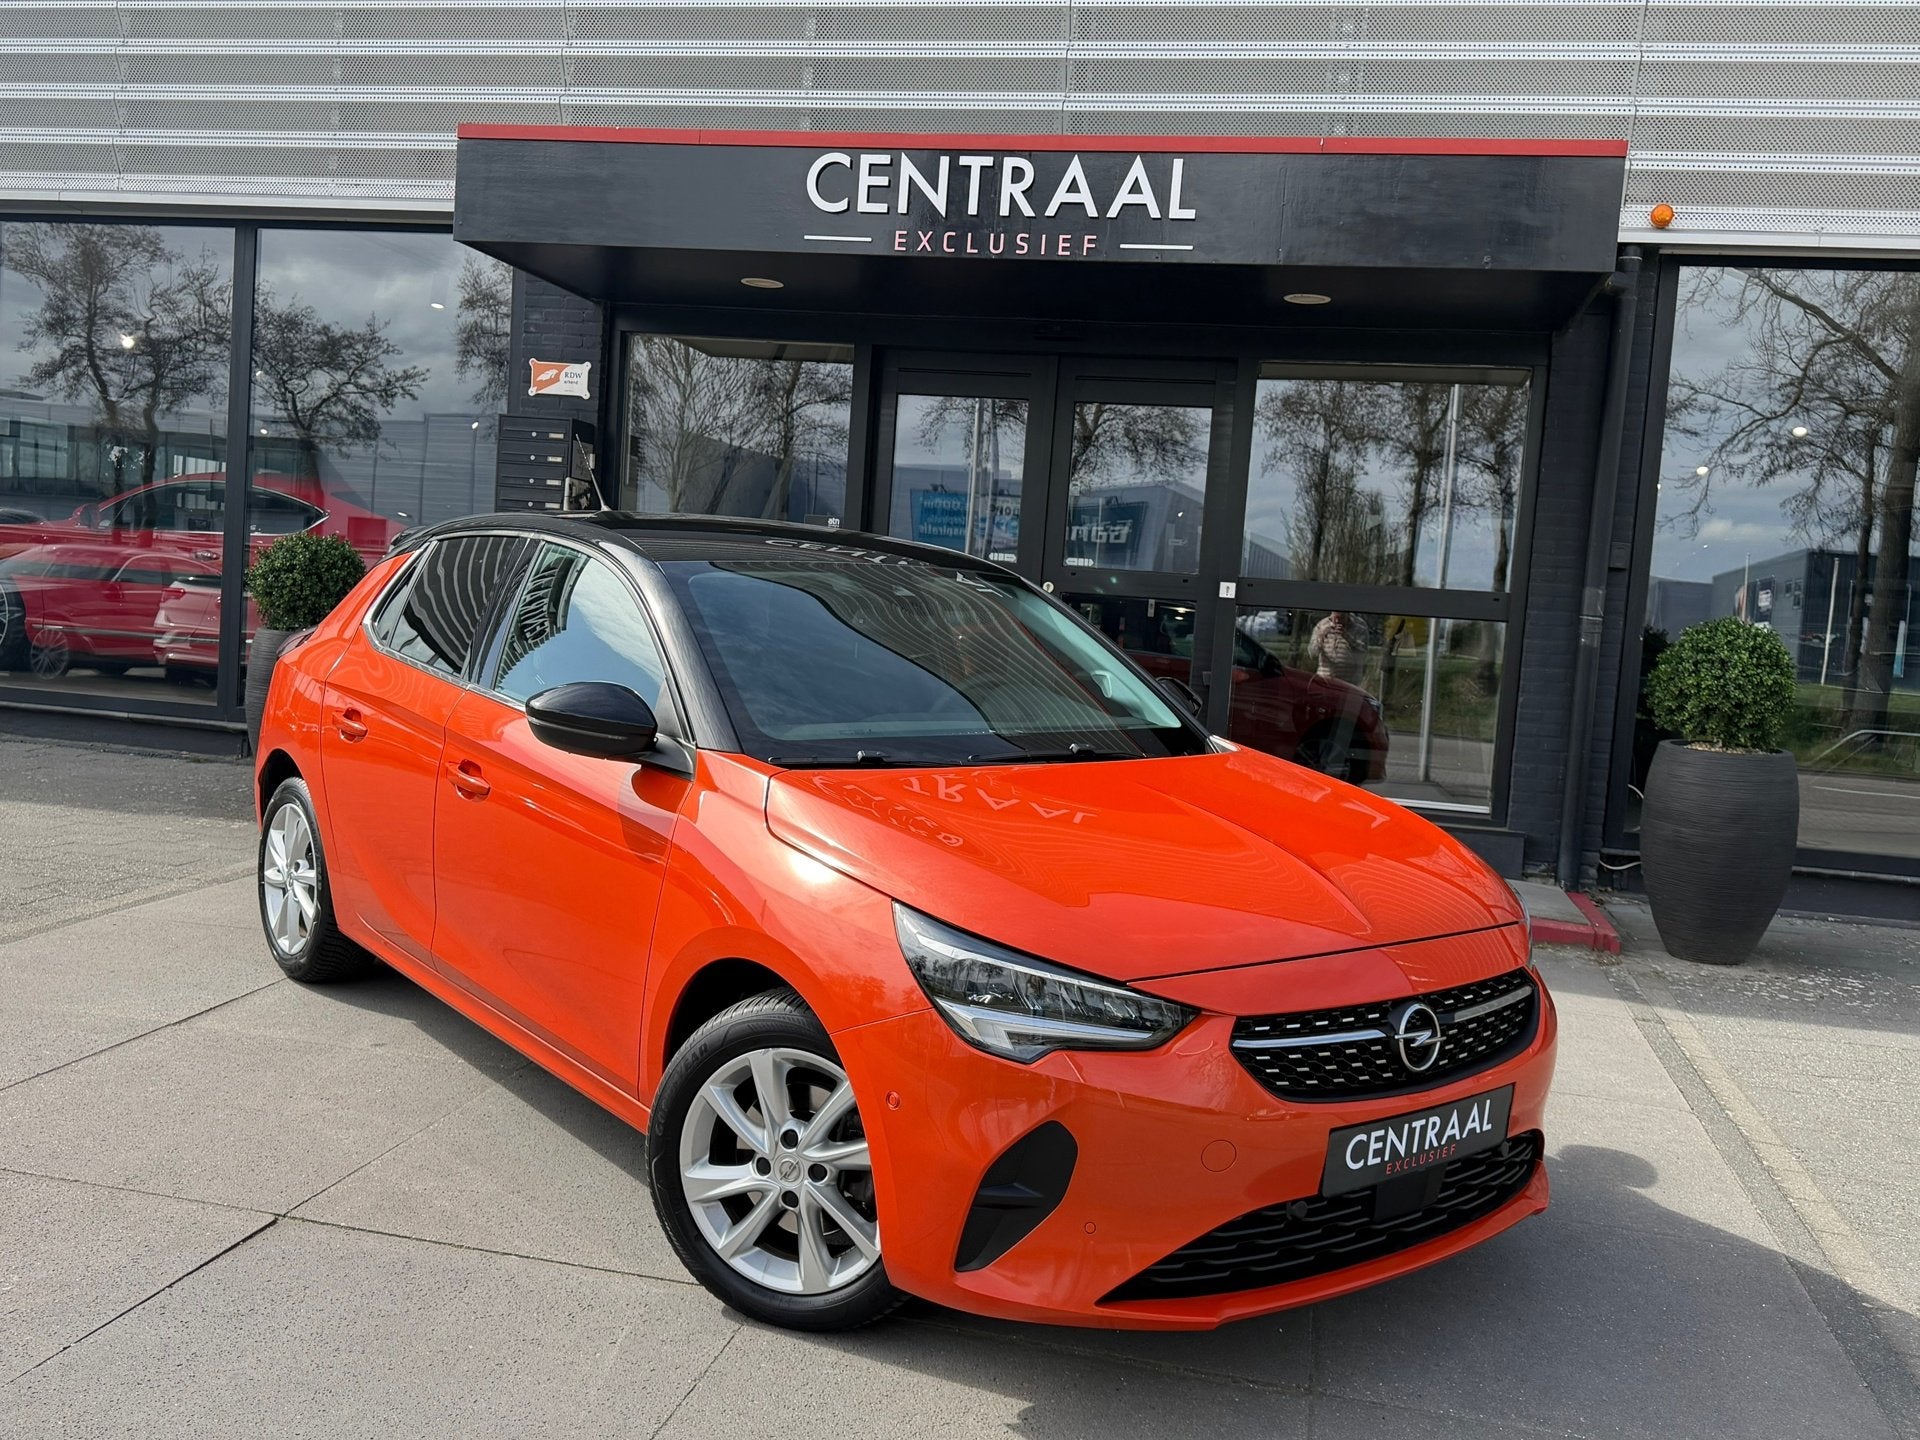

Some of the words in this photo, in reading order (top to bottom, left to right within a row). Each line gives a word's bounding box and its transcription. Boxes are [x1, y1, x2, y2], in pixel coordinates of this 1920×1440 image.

[806, 152, 1197, 220] CENTRAAL
[894, 230, 1098, 256] EXCLUSIEF
[564, 371, 583, 379] RDW
[1345, 1099, 1492, 1170] CENTRAAL
[1386, 1144, 1457, 1175] EXCLUSIEF
